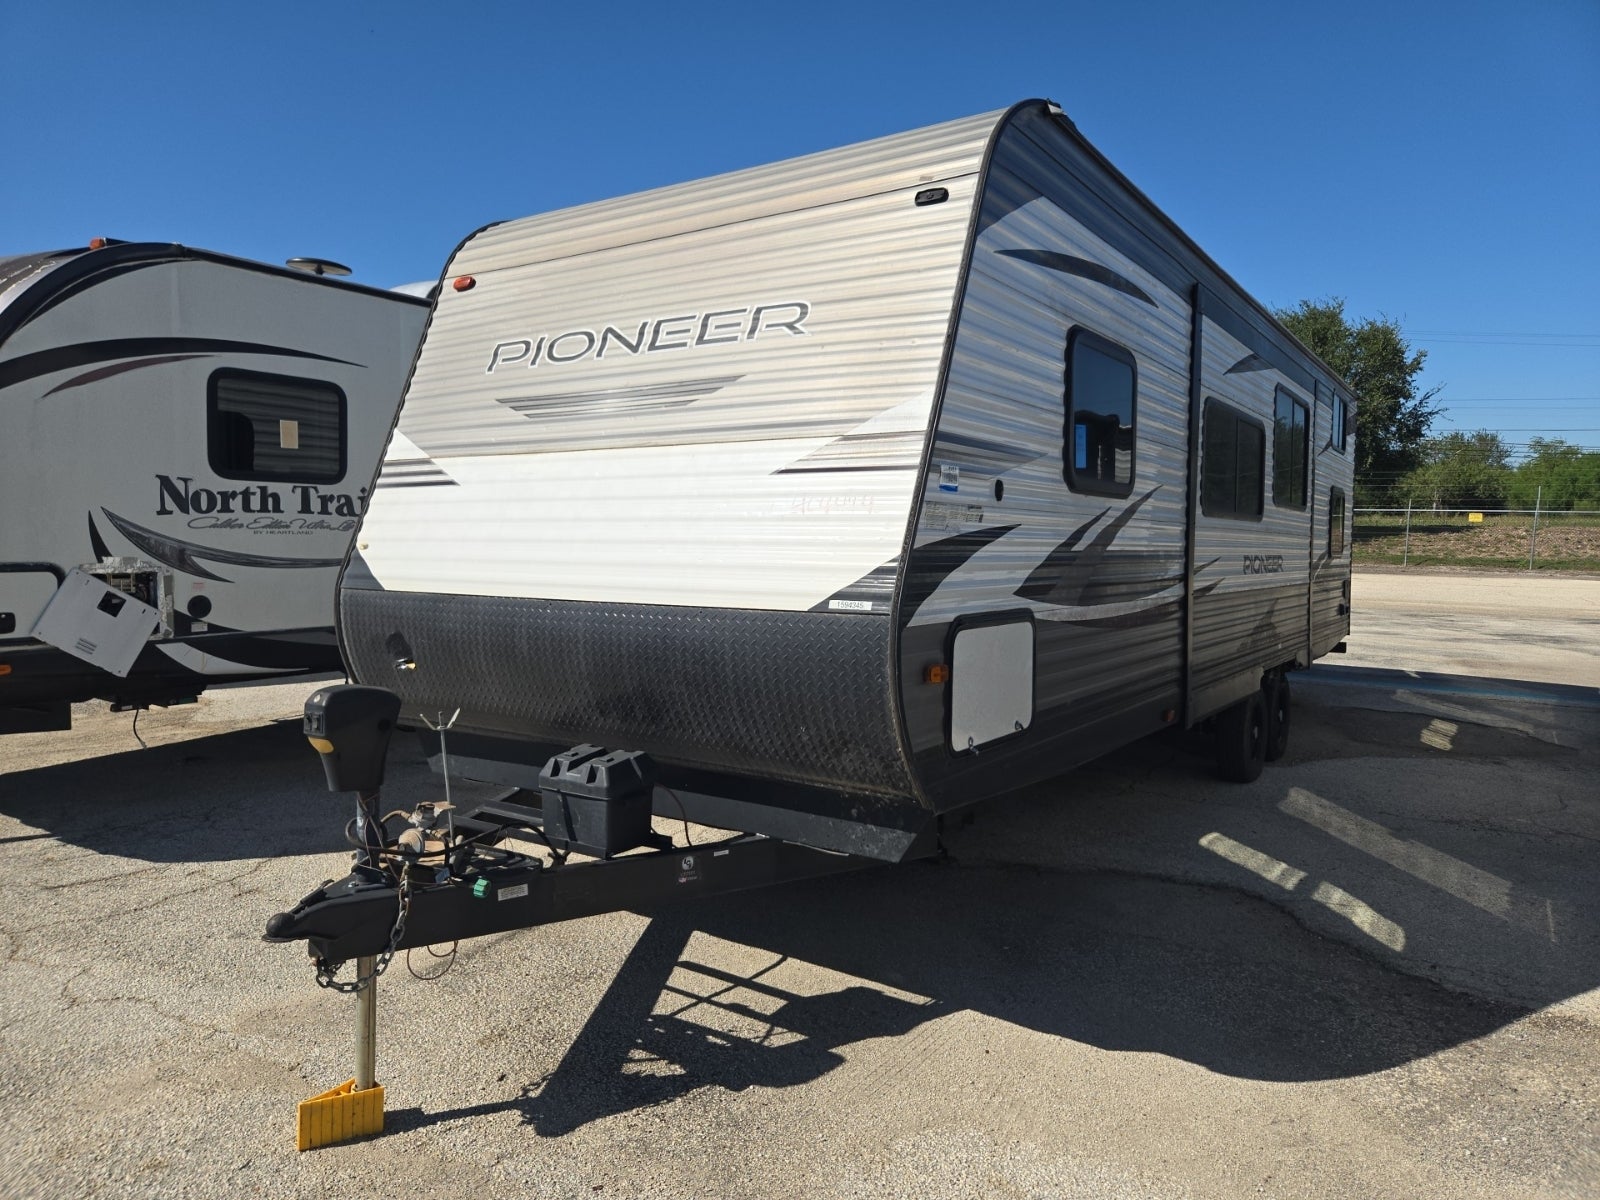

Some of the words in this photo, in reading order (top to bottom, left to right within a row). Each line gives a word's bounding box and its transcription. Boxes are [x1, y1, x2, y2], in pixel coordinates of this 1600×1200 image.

[485, 301, 812, 374] PIONEER
[155, 474, 285, 516] North
[1242, 554, 1284, 575] PIONEER
